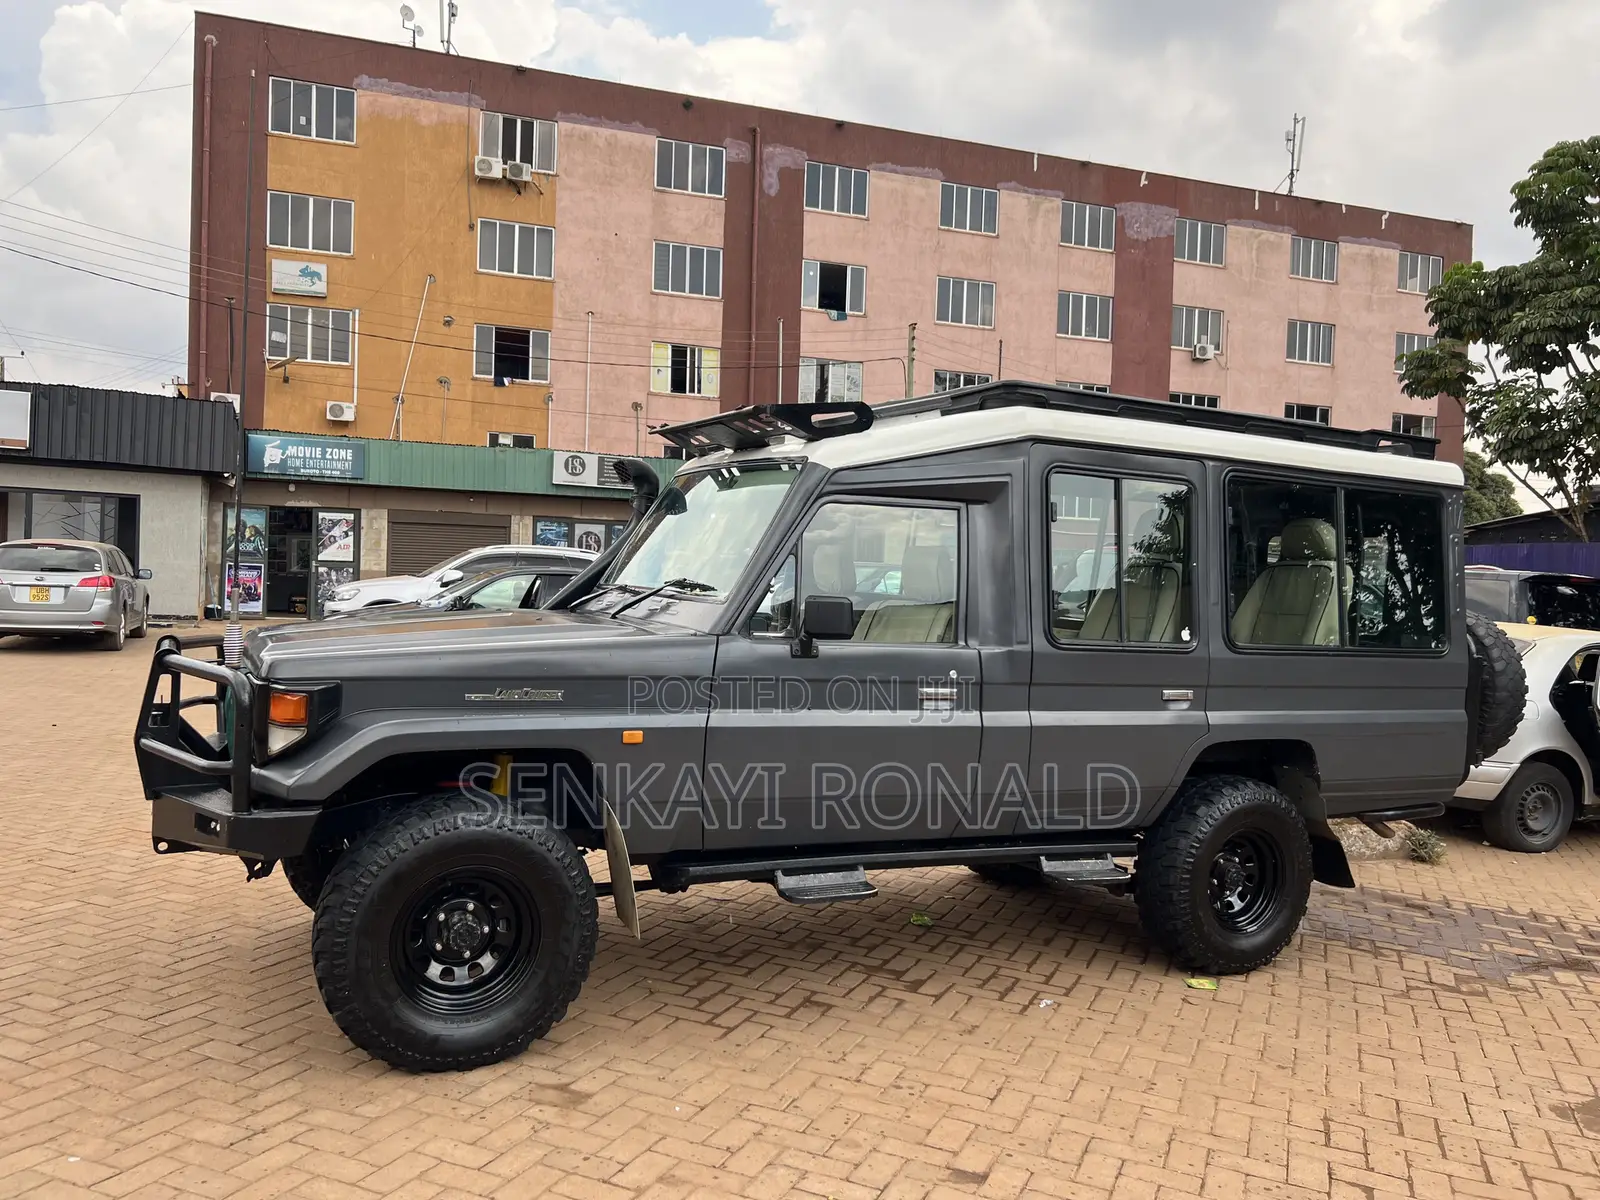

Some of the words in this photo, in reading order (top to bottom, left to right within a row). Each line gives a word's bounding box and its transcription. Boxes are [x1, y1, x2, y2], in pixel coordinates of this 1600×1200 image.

[287, 445, 322, 458] MOVIE
[326, 447, 353, 460] ZONE
[287, 458, 304, 468] HOME
[306, 459, 352, 471] ENTERTAINMENT
